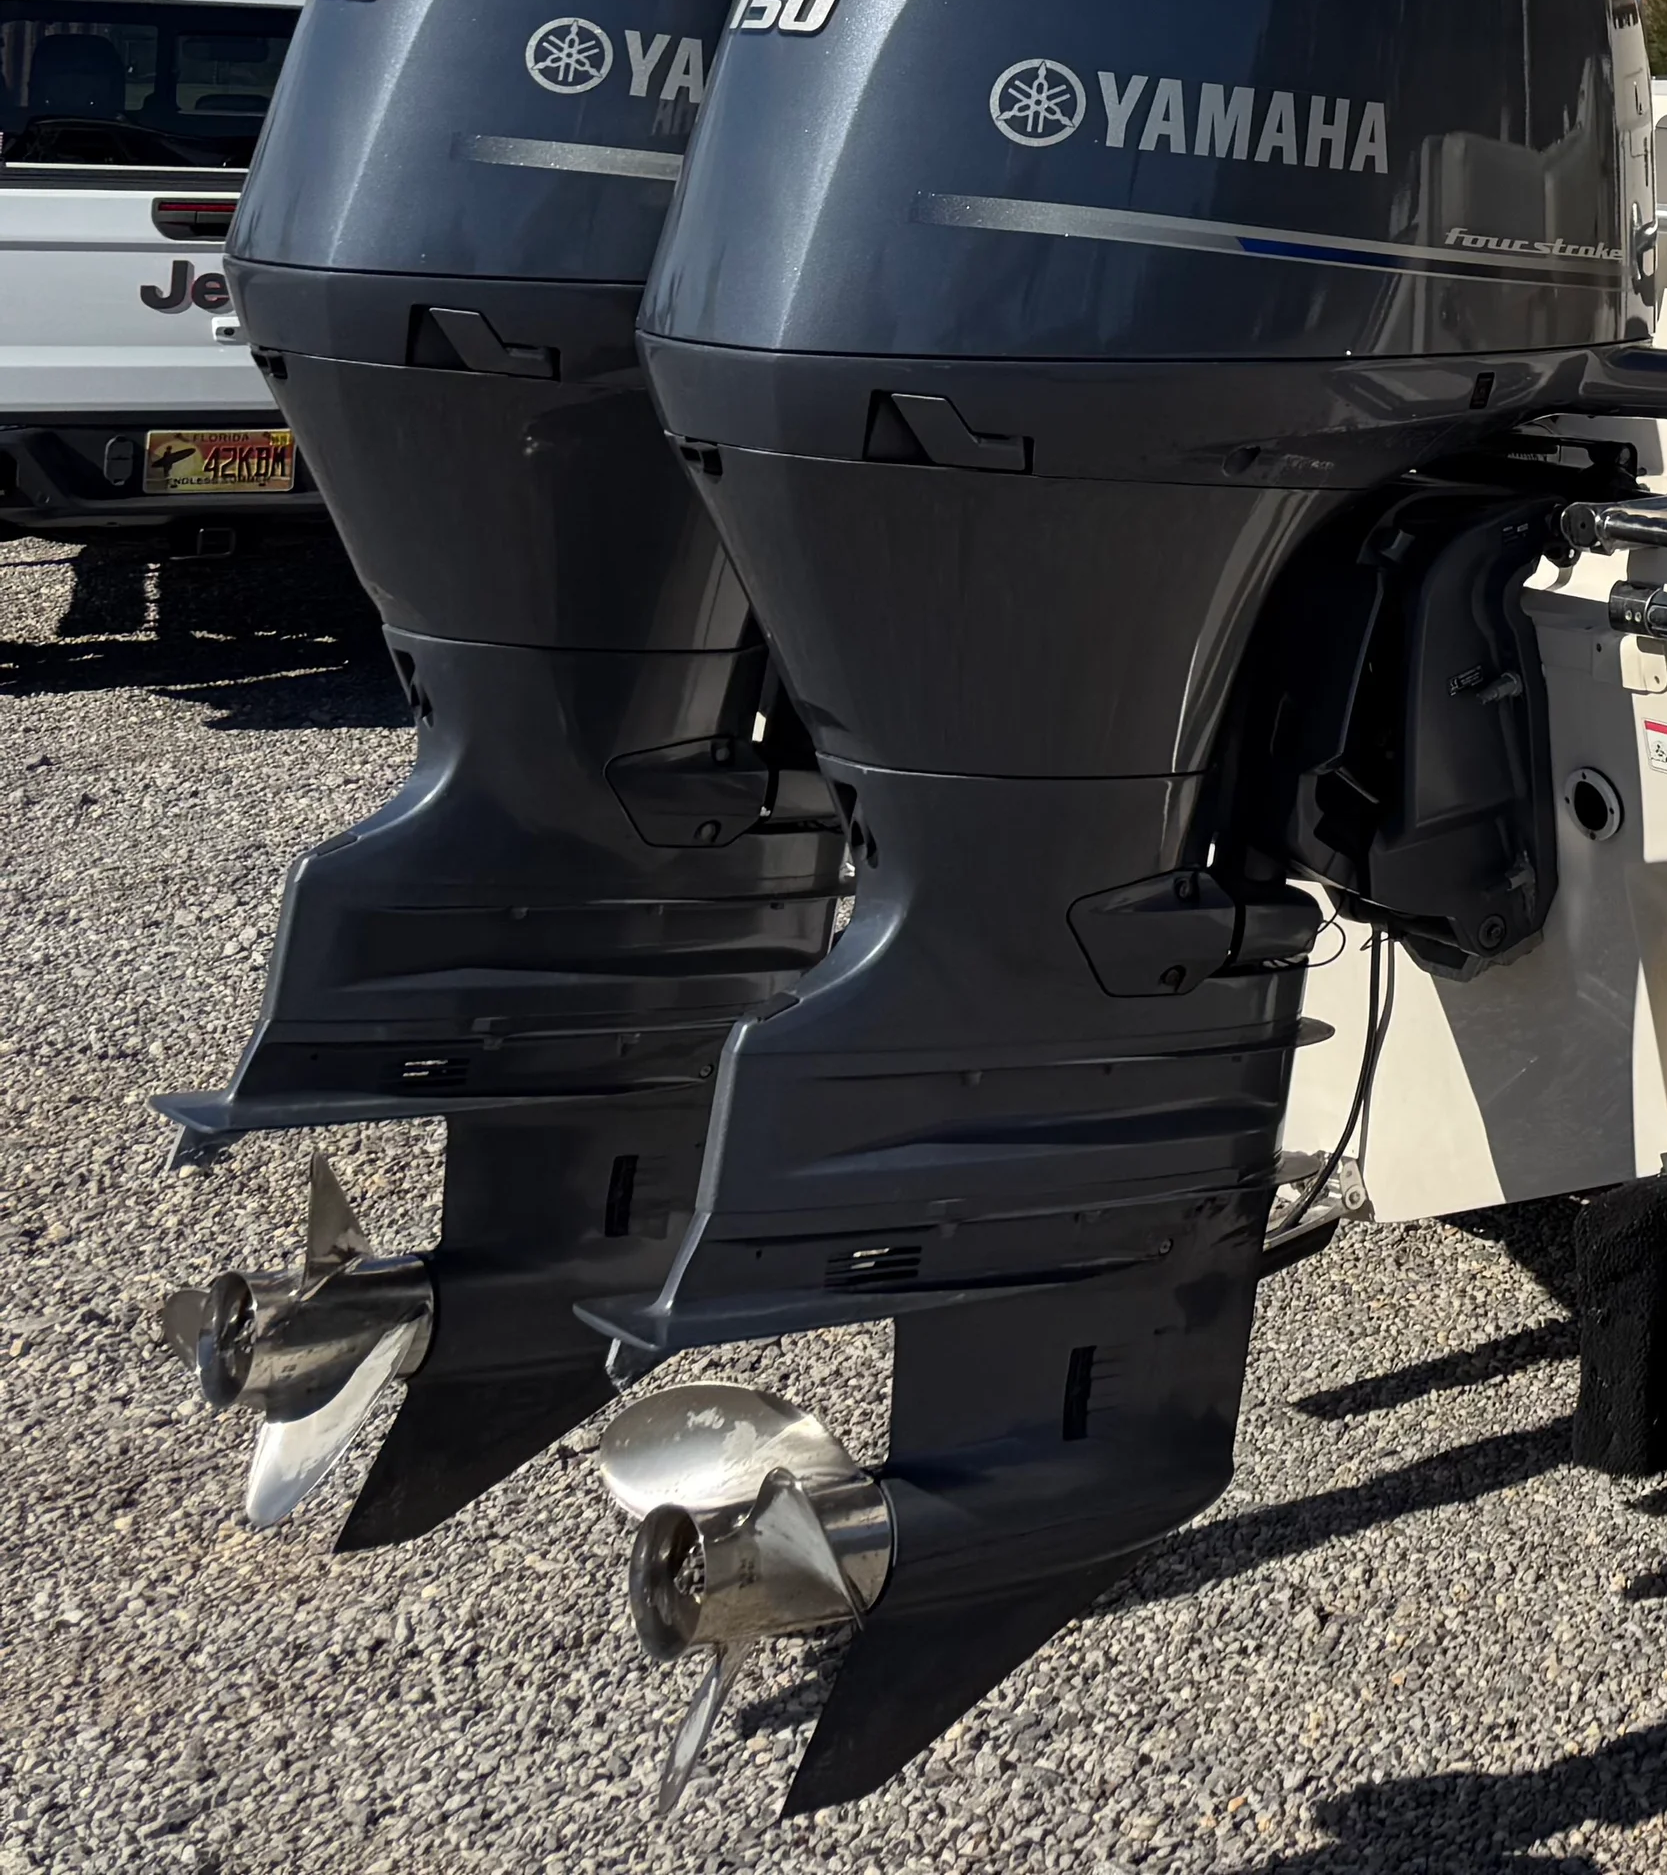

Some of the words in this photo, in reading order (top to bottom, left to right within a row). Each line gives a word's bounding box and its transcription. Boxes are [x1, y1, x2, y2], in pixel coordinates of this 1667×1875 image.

[623, 29, 706, 104] YA
[1097, 70, 1389, 174] YAMAHA
[140, 260, 231, 312] Je
[192, 433, 251, 443] FLORIDA
